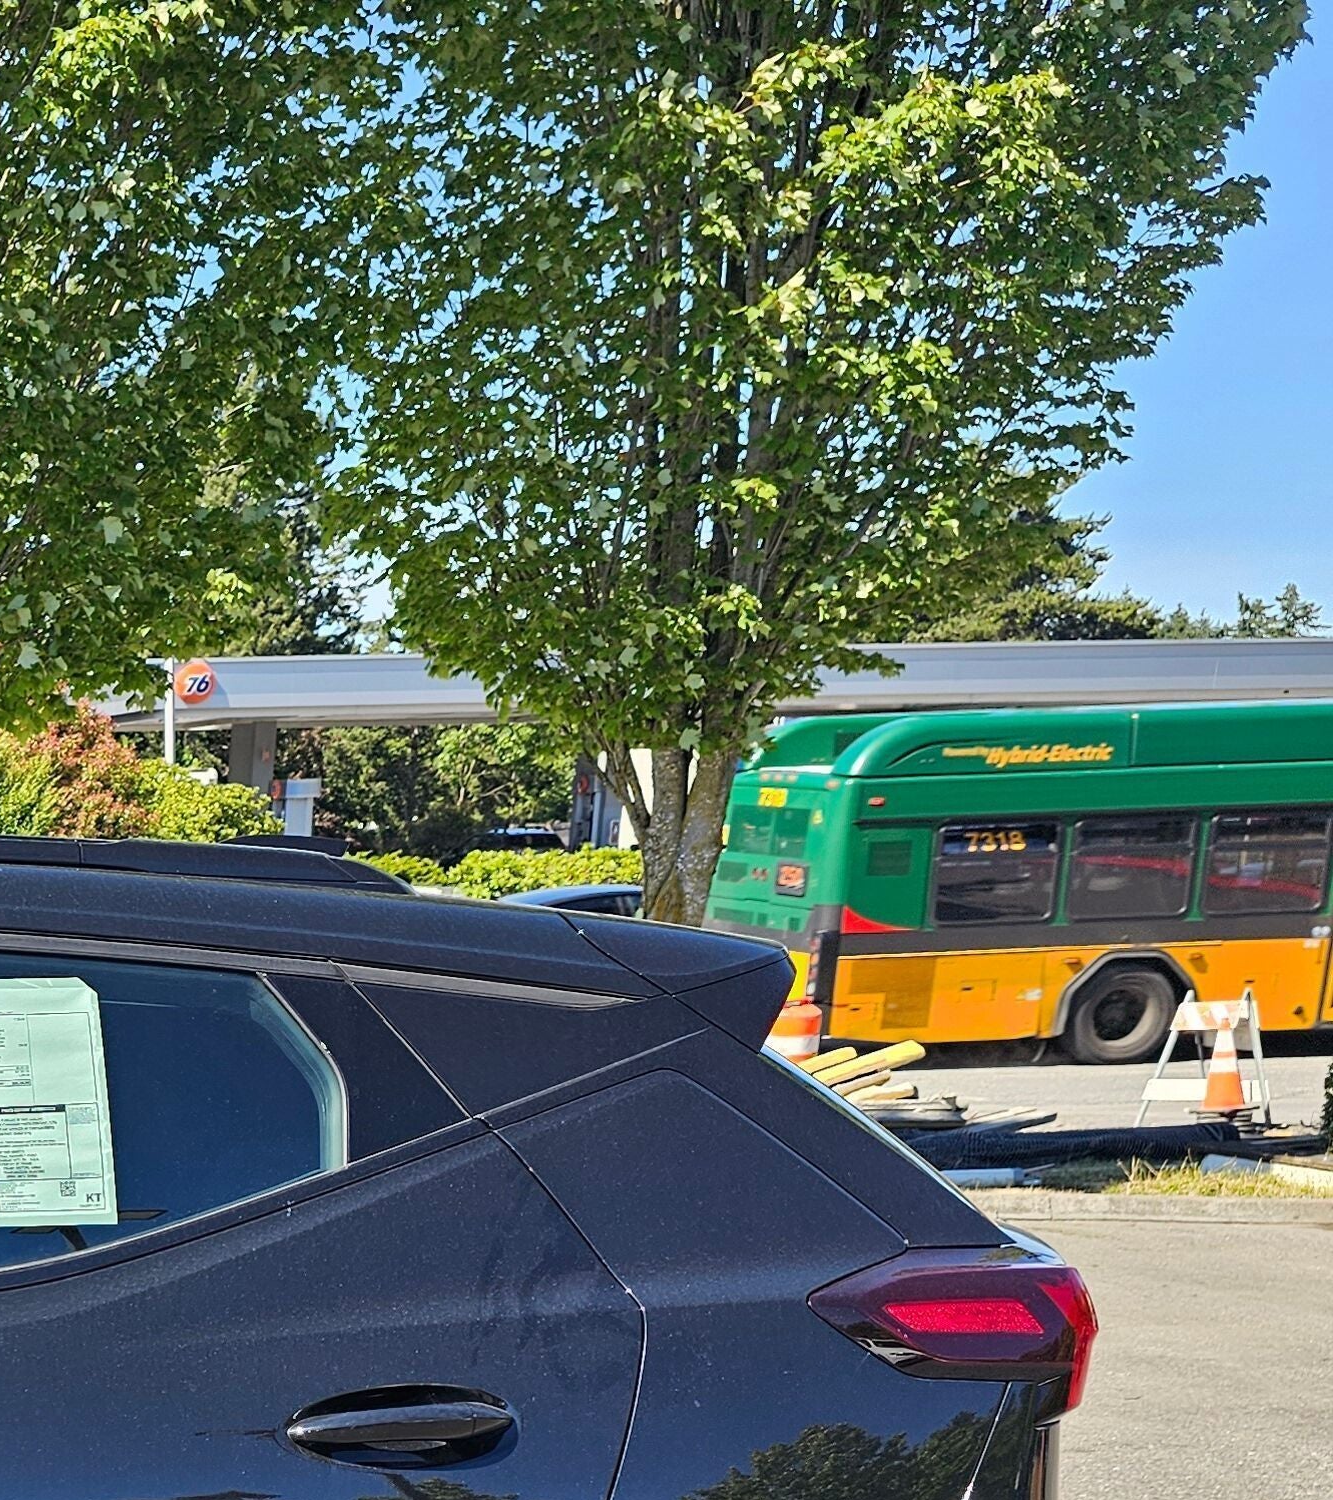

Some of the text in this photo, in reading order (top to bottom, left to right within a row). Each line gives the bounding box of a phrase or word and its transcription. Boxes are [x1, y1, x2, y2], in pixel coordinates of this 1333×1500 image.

[186, 674, 210, 693] 76
[986, 742, 1114, 768] Hybrid-Electric
[964, 831, 1027, 853] 7318
[85, 1192, 101, 1202] KT
